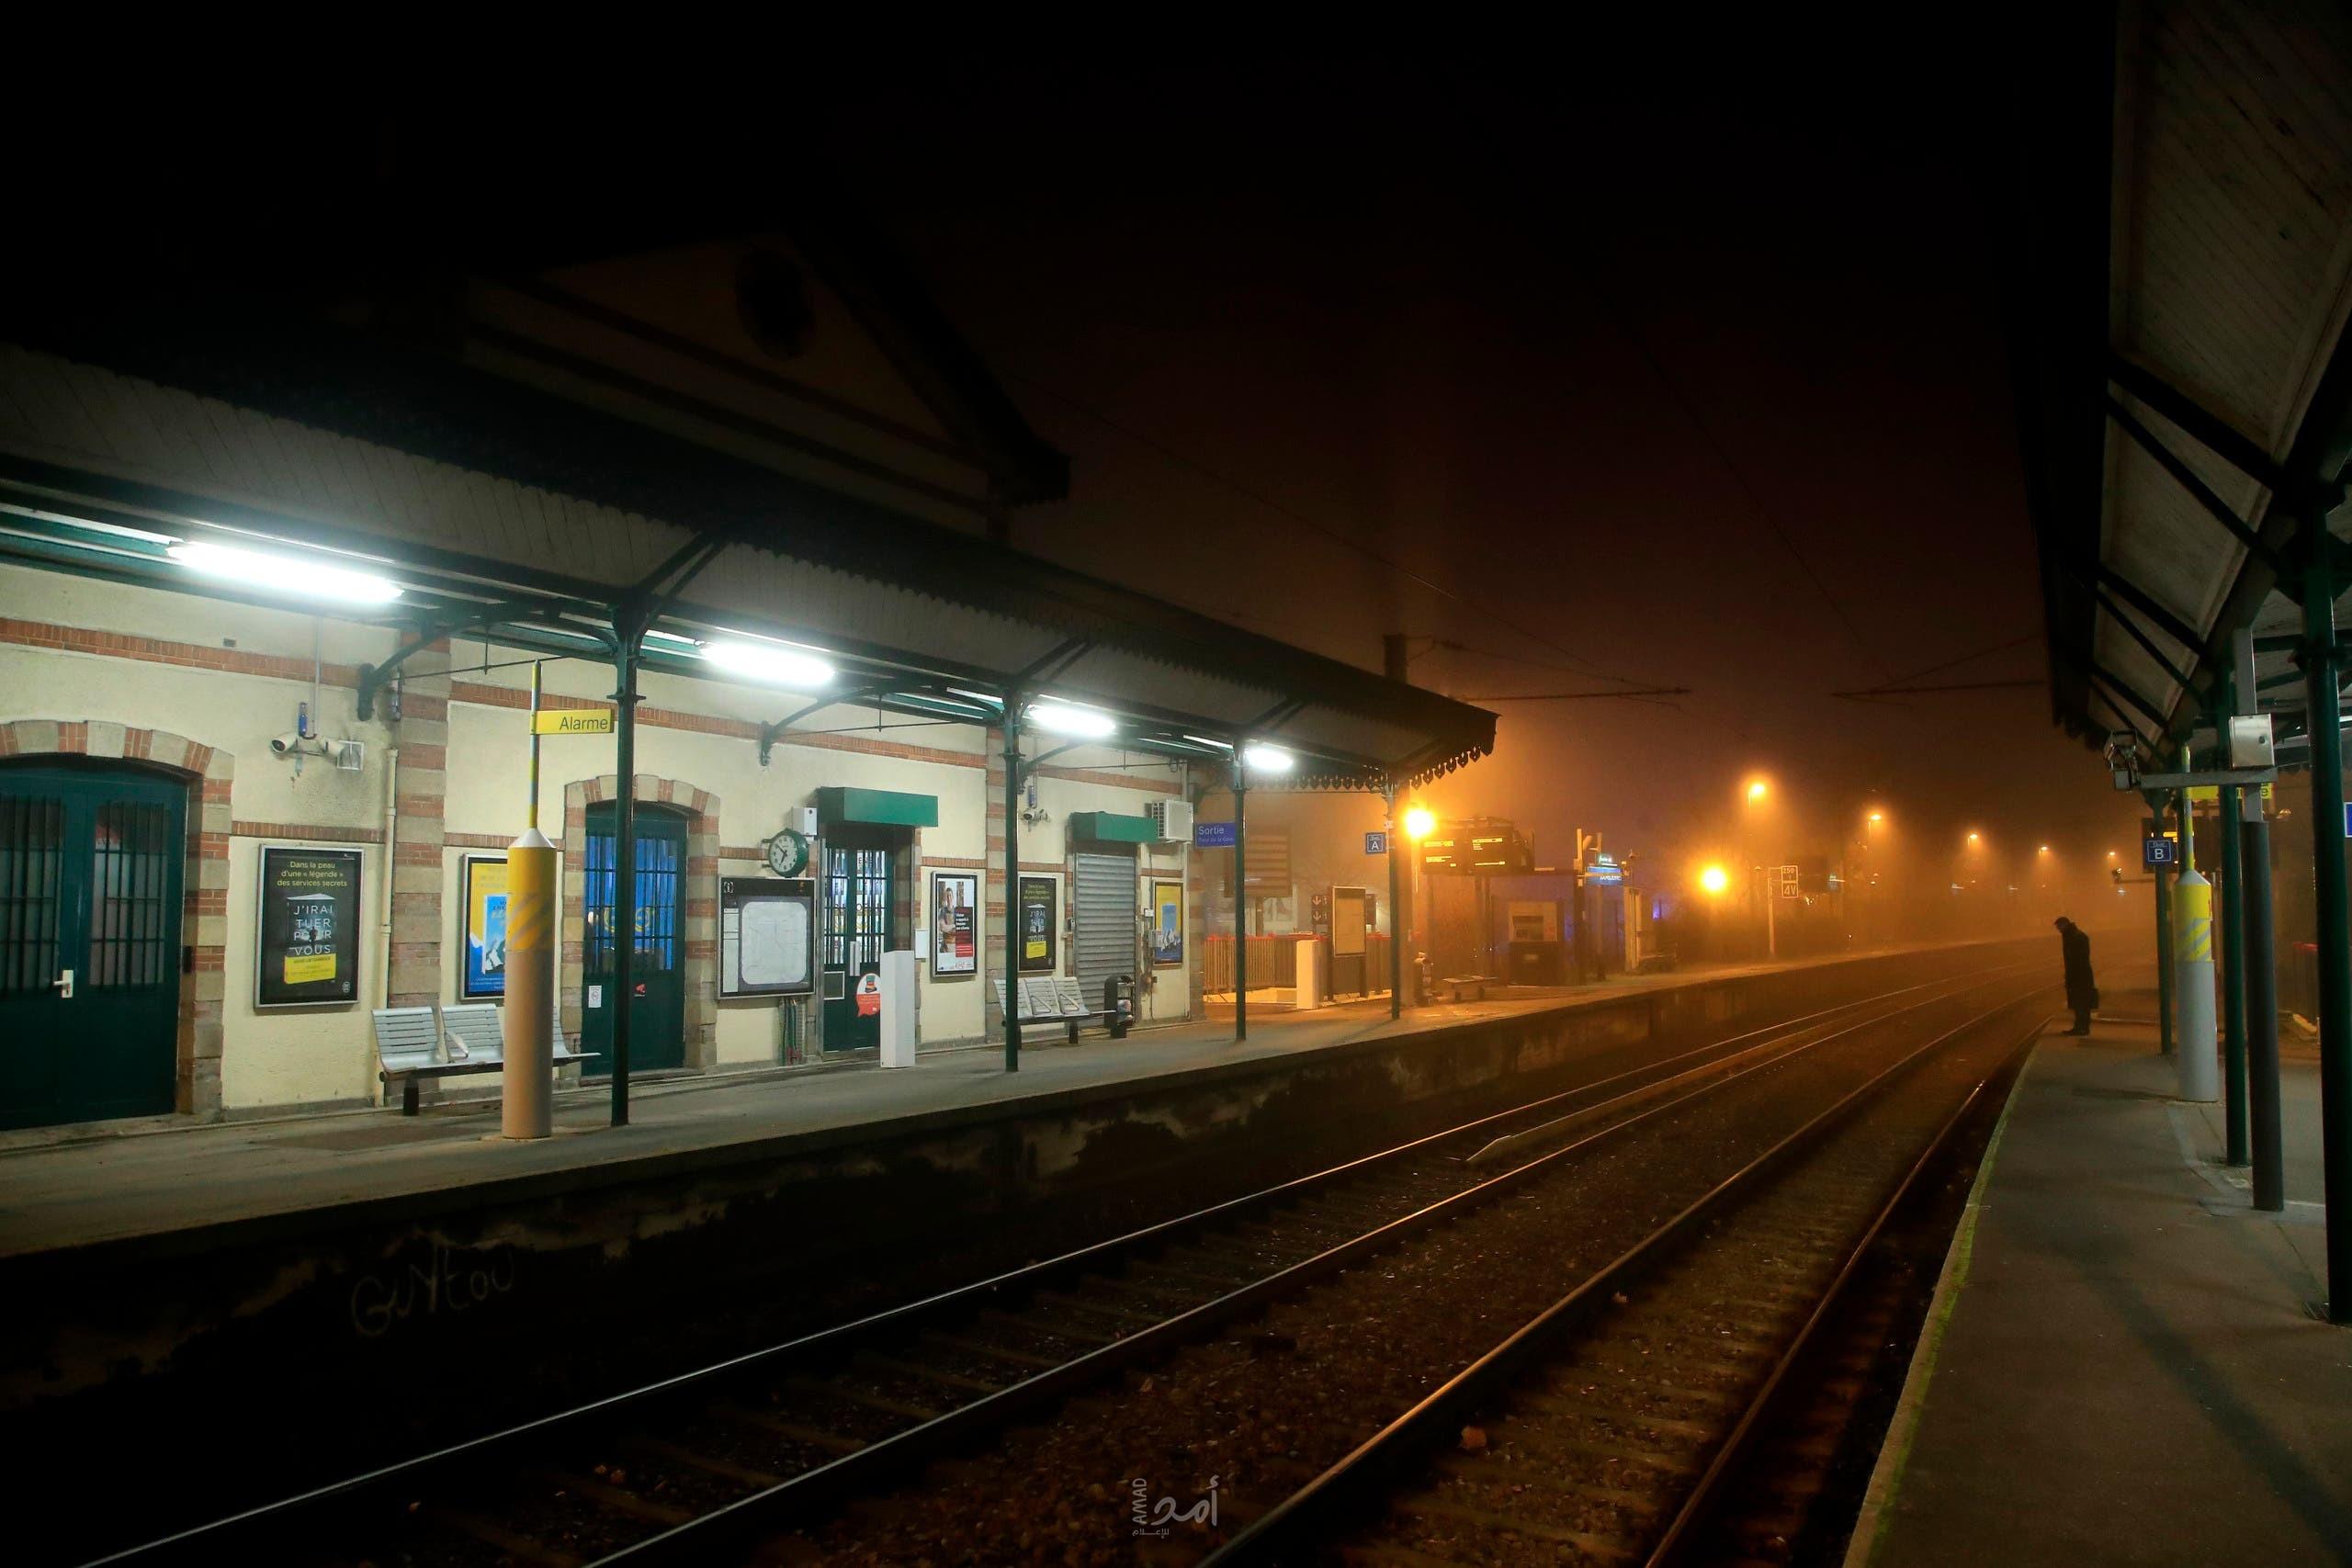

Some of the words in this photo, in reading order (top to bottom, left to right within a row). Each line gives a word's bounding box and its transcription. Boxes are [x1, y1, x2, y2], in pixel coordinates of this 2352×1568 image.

[559, 716, 608, 731] Alarme
[1198, 825, 1225, 835] Sortie
[1371, 840, 1379, 851] A
[2154, 848, 2165, 859] B
[294, 905, 333, 915] J'IRAI
[296, 918, 331, 929] TUER
[294, 944, 331, 955] VOUS
